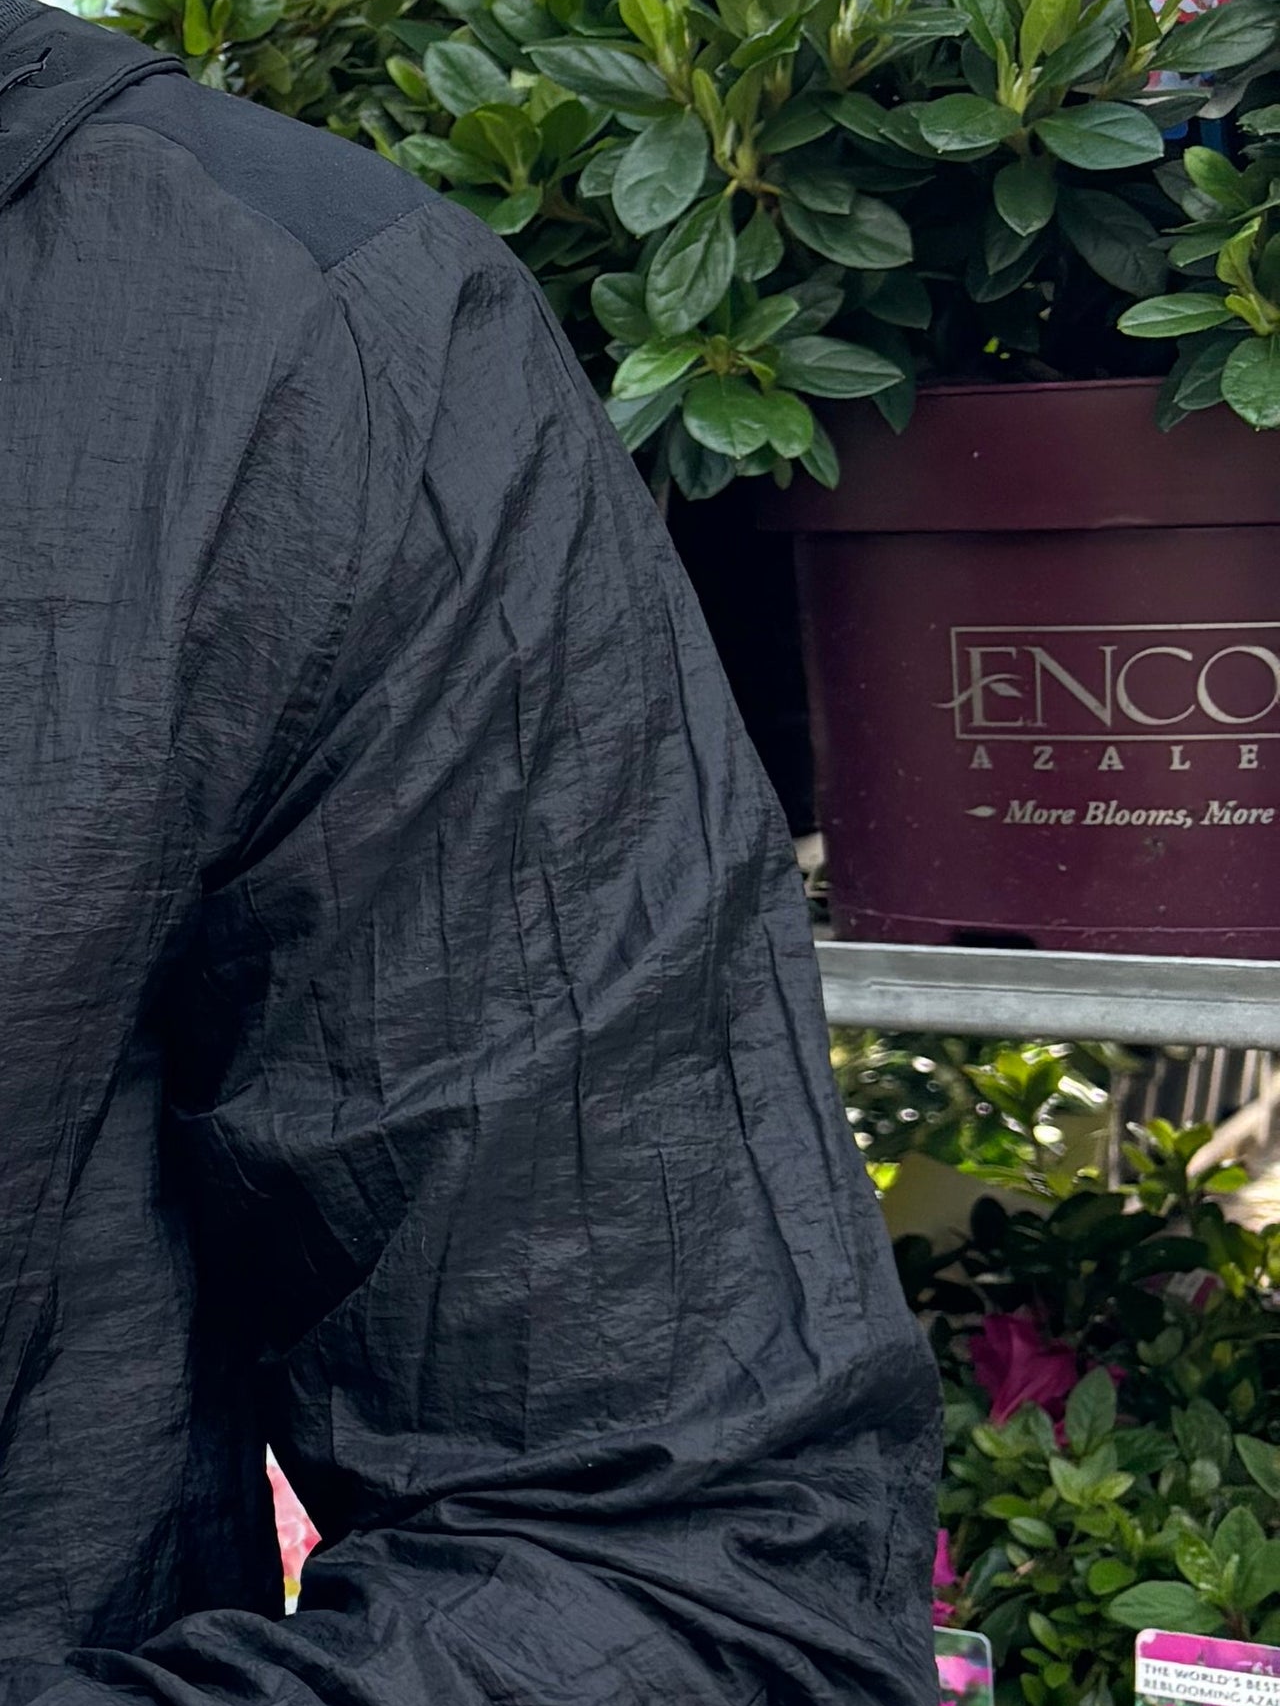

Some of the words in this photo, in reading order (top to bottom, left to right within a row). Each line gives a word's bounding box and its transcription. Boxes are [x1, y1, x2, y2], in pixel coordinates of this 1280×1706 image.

[1003, 800, 1076, 825] More
[1081, 800, 1193, 829] Blooms,
[1200, 800, 1275, 826] More
[1143, 1663, 1173, 1677] THE
[1175, 1668, 1242, 1688] WORLD'S
[1143, 1678, 1241, 1703] REBLOOMING
